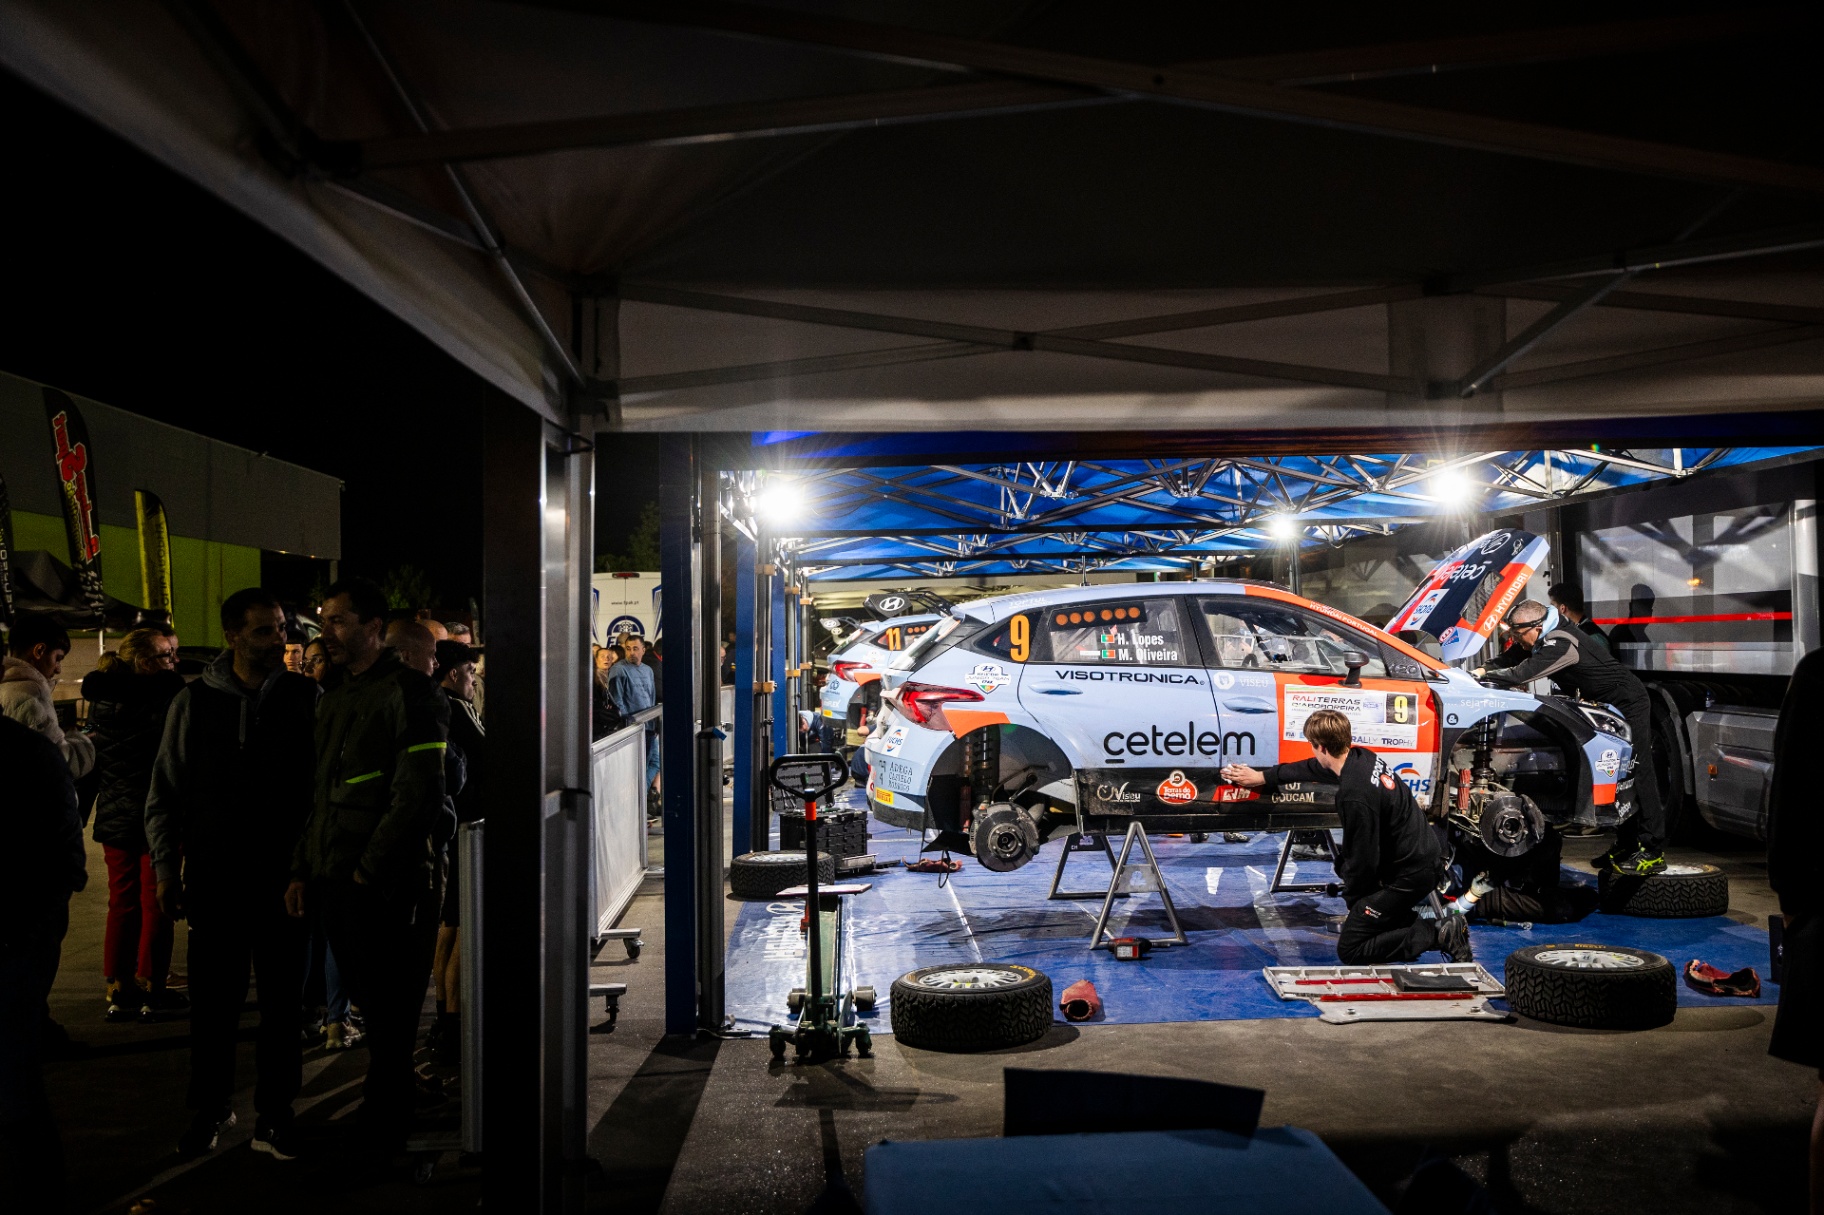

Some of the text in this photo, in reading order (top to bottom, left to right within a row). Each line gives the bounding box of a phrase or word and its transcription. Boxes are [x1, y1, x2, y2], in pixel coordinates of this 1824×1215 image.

[1495, 573, 1529, 615] HYUNDAI
[1309, 604, 1342, 620] HYUNDAI
[1342, 617, 1379, 637] PORTUGAL
[886, 627, 902, 651] 11
[1010, 614, 1030, 662] 9
[1117, 634, 1164, 647] H. Lopes
[1118, 649, 1178, 661] M. Oliveira
[1317, 696, 1361, 705] TERRAS
[1460, 699, 1480, 709] seja
[1394, 695, 1408, 723] 9
[1104, 722, 1256, 763] cetelem
[1351, 736, 1415, 747] RALLY TROPHY
[889, 761, 913, 776] ADEGA
[1163, 786, 1191, 794] Terras do
[1271, 792, 1315, 804] GOUCAM
